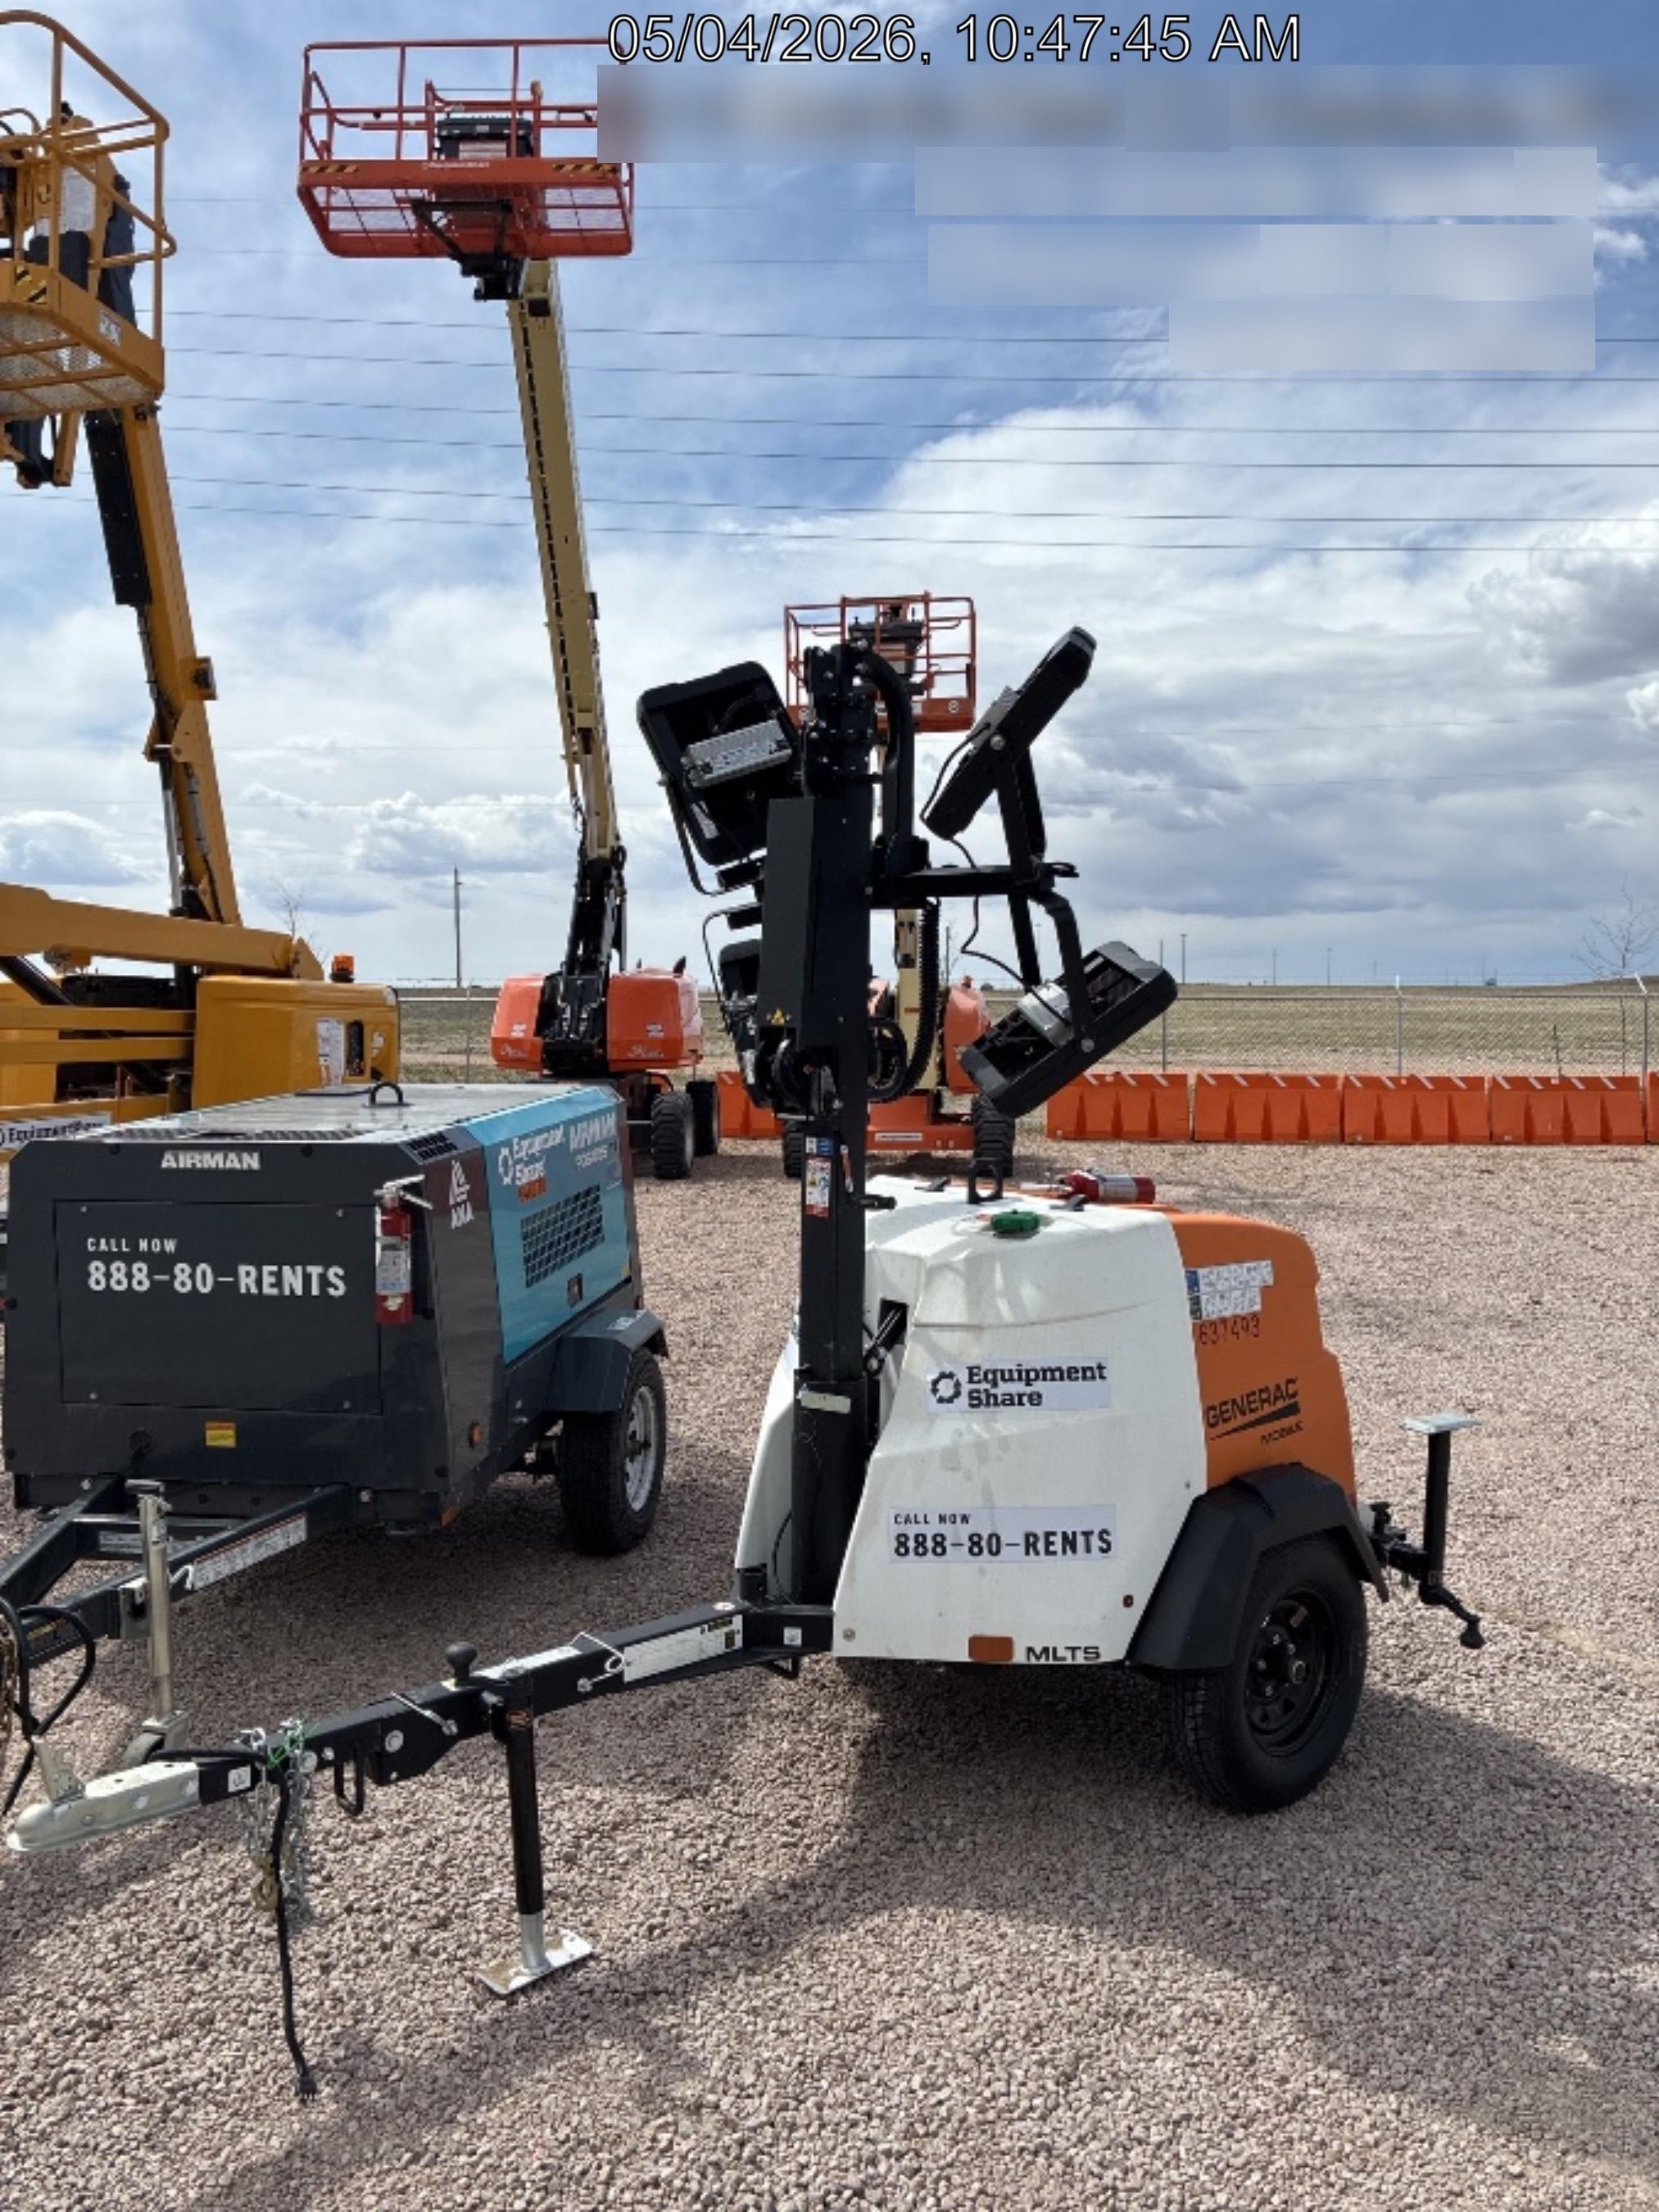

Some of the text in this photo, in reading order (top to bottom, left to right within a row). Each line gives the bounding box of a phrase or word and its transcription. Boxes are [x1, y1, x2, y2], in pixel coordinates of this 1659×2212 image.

[161, 1149, 261, 1171] AIRMAN
[87, 1238, 178, 1254] CALL NOW
[87, 1260, 347, 1298] 888-80-RENTS
[966, 1362, 1107, 1389] Equipment
[968, 1388, 1044, 1409] Share
[1205, 1376, 1299, 1429] GENERAC
[894, 1513, 972, 1525] CALL NOW
[894, 1528, 1113, 1557] 888-80-RENTS
[1026, 1645, 1101, 1662] MLTS
